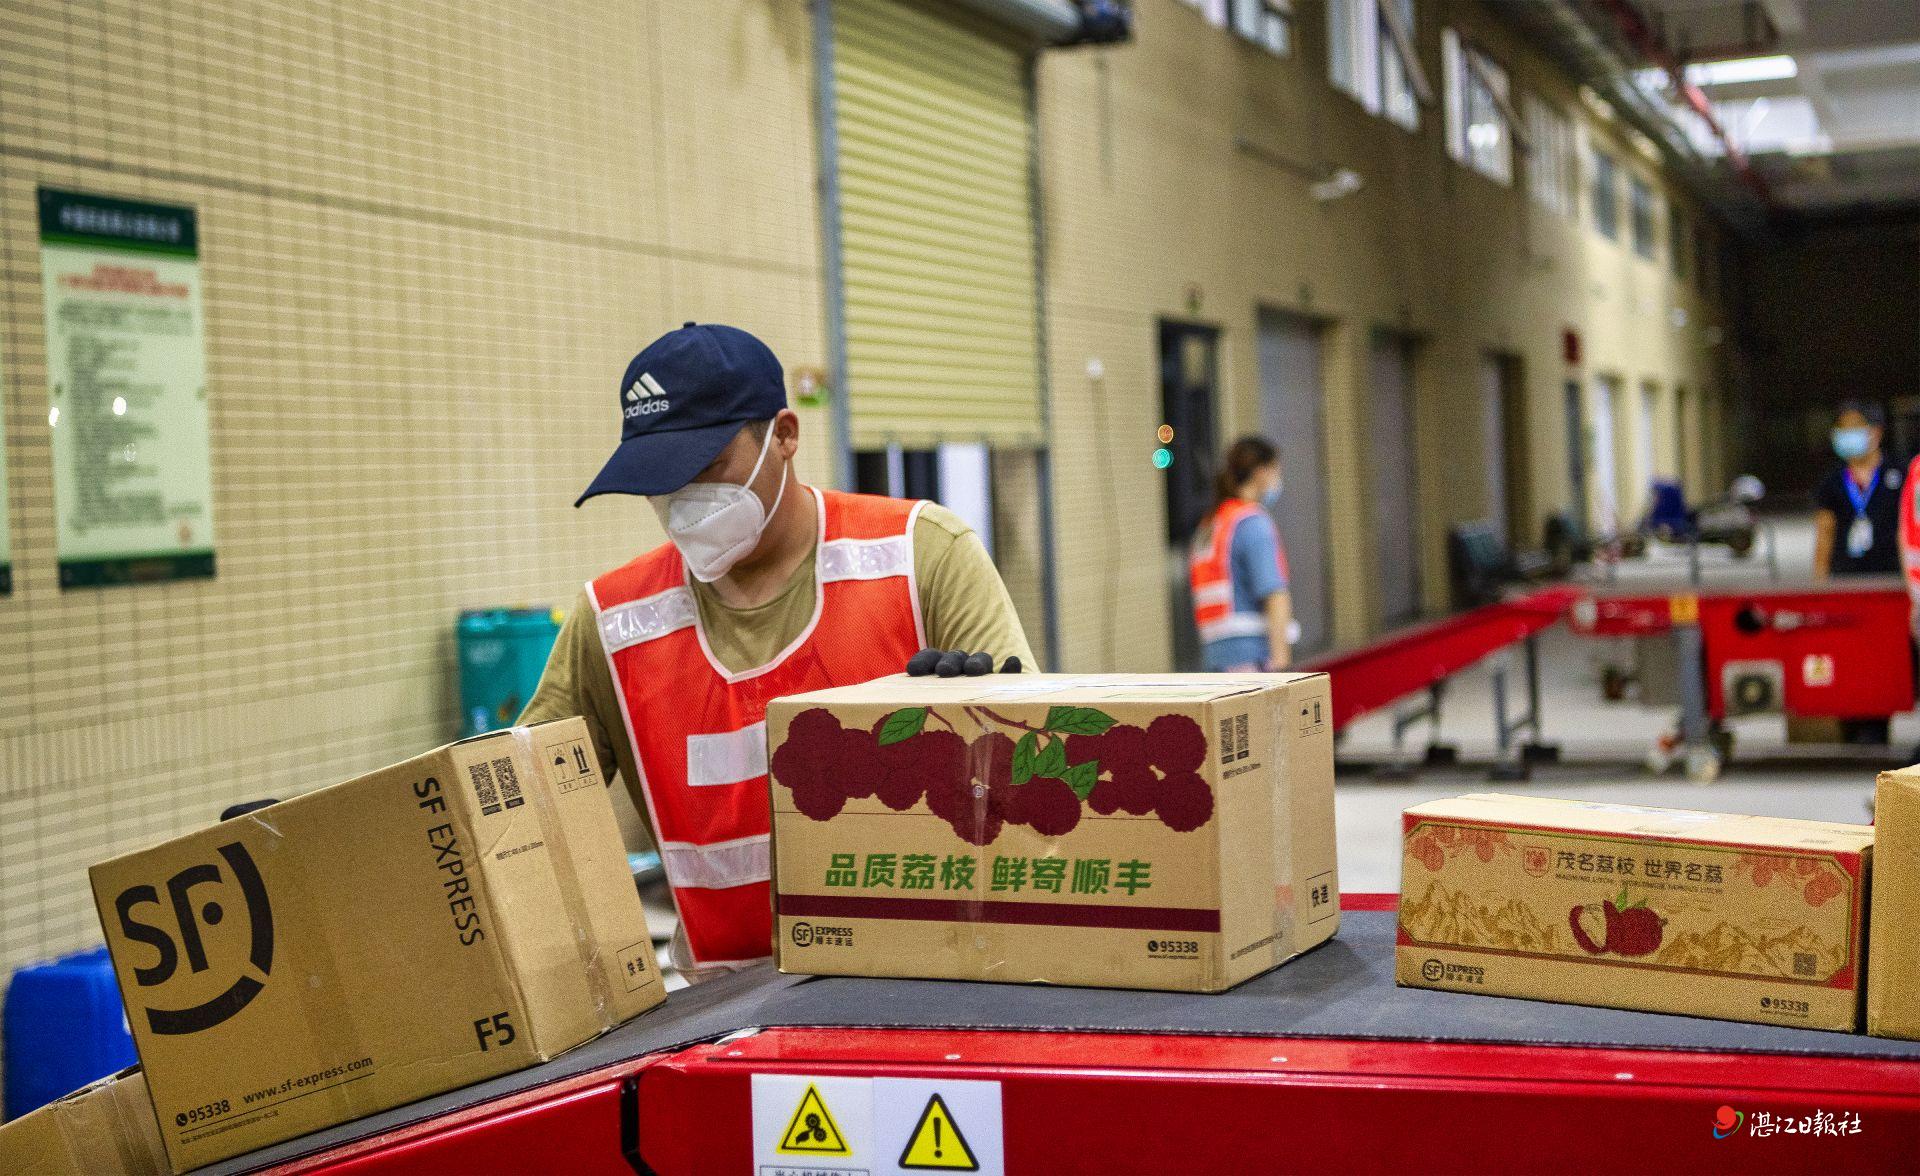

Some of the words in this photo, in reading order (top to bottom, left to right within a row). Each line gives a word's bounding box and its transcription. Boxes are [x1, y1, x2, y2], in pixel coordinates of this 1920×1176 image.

[624, 399, 670, 419] adidas
[413, 777, 446, 814] SF
[427, 823, 485, 946] EXPRESS
[825, 853, 978, 891] 品质荔枝
[990, 855, 1152, 895] 鲜寄顺丰
[1555, 851, 1635, 876] 茂名荔枝
[1643, 858, 1724, 884] 世界名荔
[794, 926, 812, 943] SF
[815, 926, 854, 937] EXPRESS
[1159, 941, 1199, 953] 95338
[473, 1012, 516, 1051] F5
[188, 1099, 231, 1124] 95338
[242, 1056, 373, 1104] www.sf-express.com
